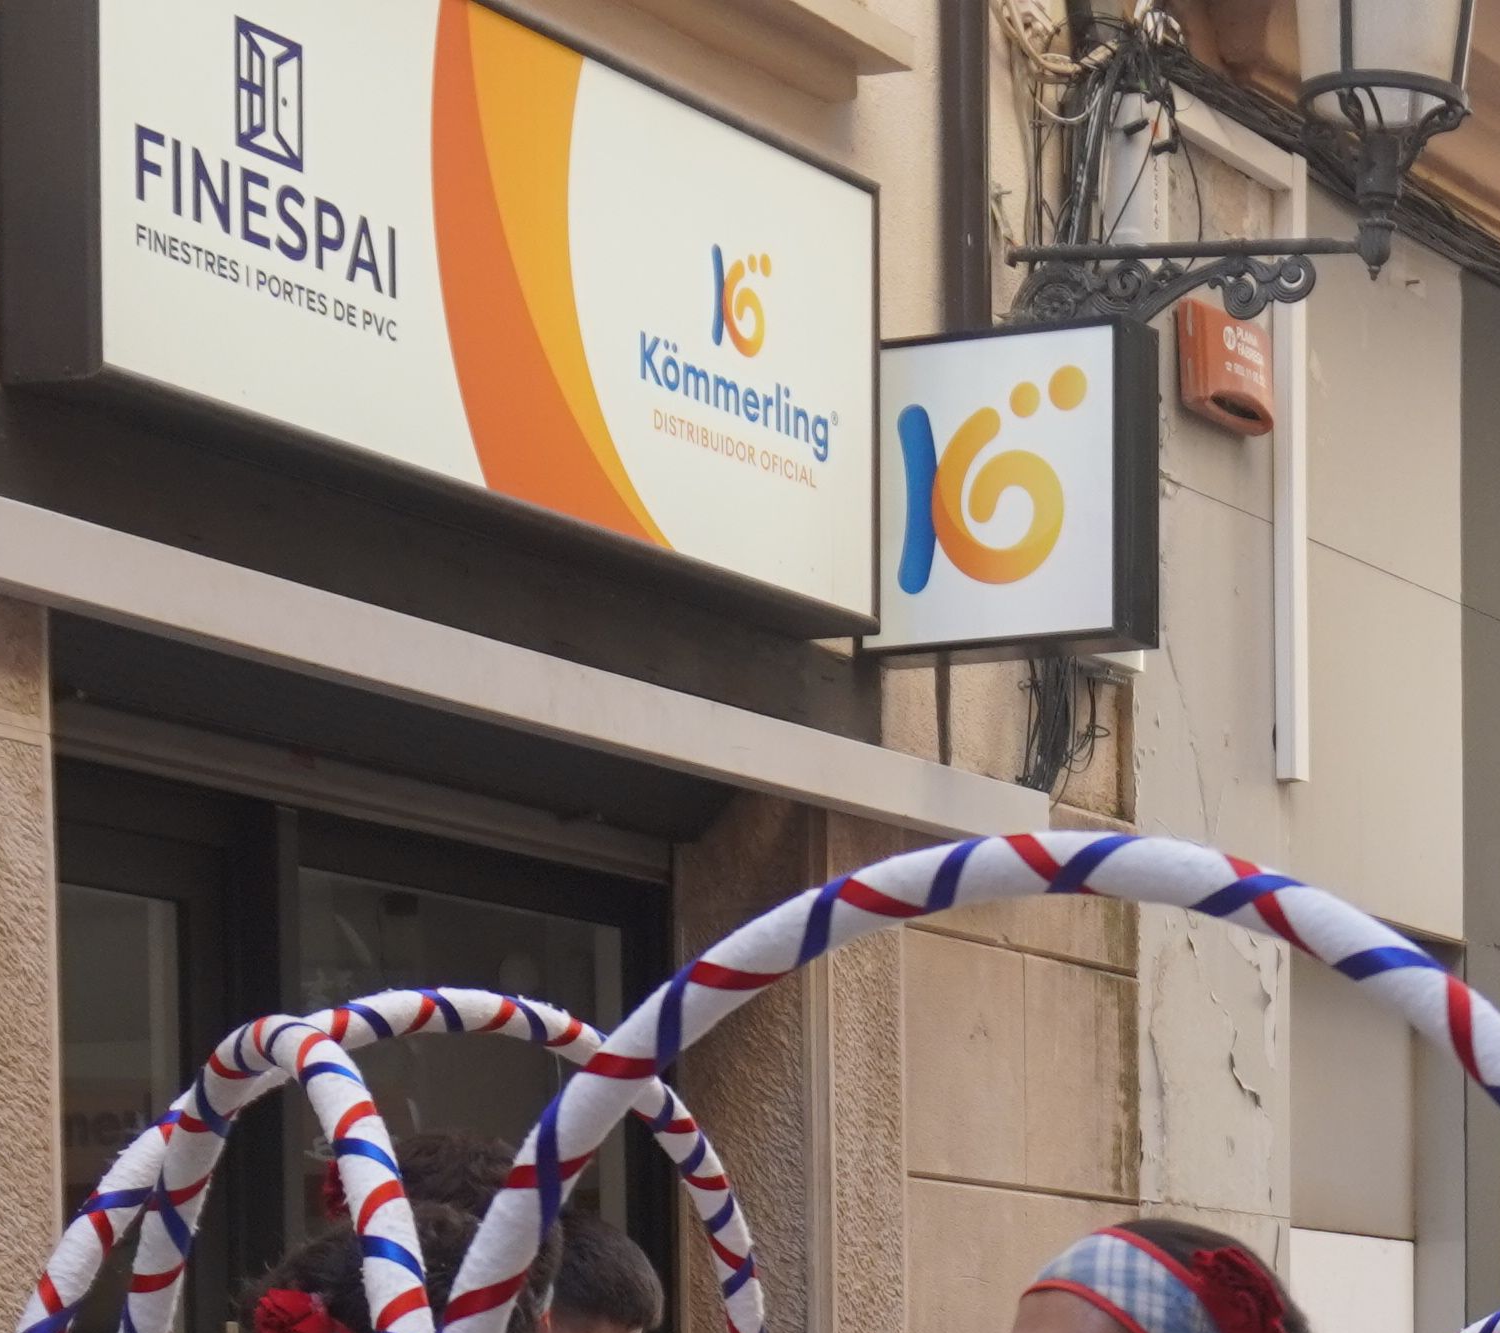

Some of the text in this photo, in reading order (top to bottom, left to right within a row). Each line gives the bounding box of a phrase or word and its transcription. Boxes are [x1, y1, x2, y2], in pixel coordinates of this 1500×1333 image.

[135, 123, 397, 299] FINESPAI
[136, 223, 397, 342] FINESTRES I PORTES DE PVC
[640, 330, 830, 463] Kömmerling
[653, 408, 818, 489] DISTRIBUIDOR OFICIAL
